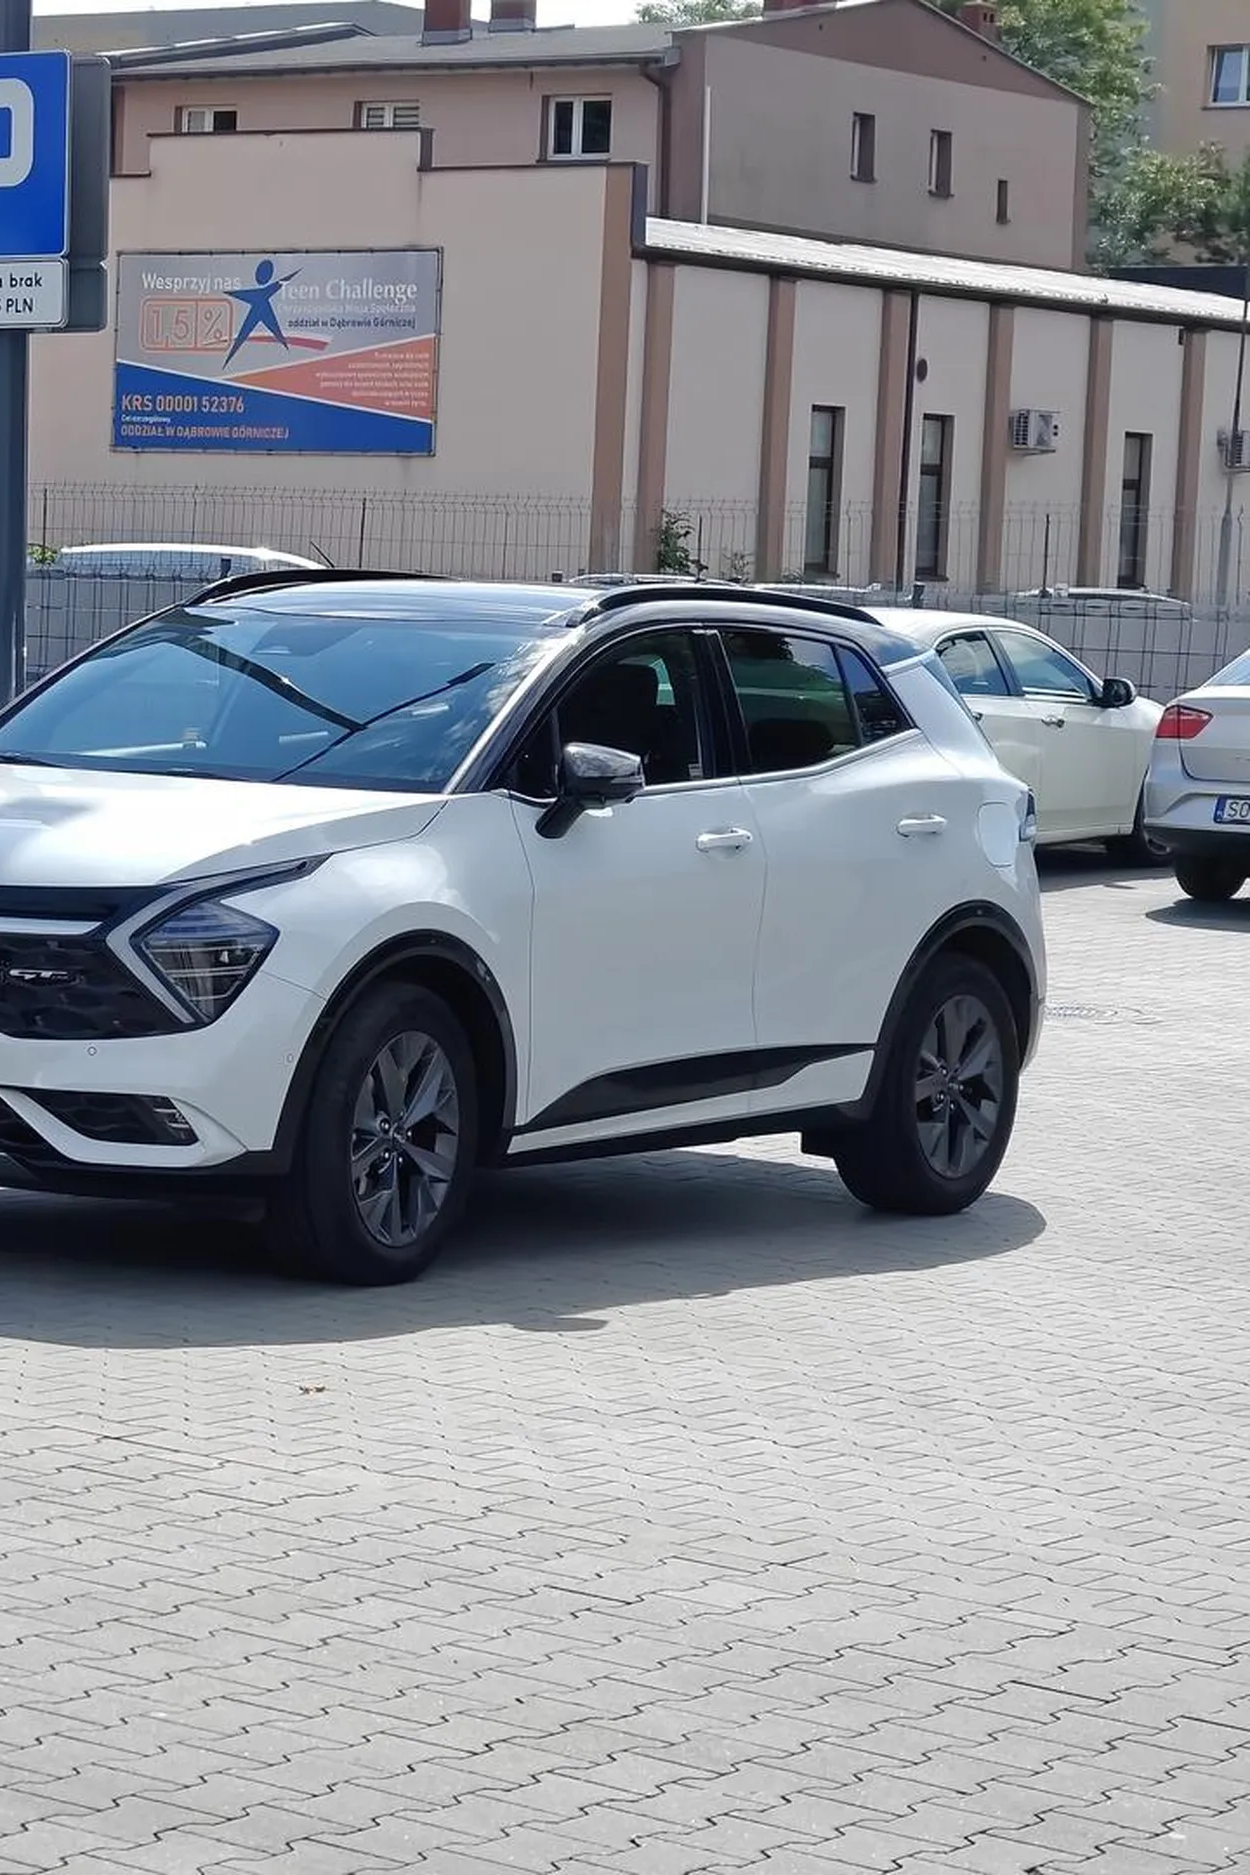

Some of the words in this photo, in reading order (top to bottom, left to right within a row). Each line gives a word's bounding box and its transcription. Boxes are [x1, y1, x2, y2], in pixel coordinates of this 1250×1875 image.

[9, 272, 43, 288] brak
[141, 271, 211, 294] Wesprzyj
[213, 276, 242, 290] nas
[325, 277, 418, 305] Challenge
[6, 298, 34, 313] PLN
[122, 395, 153, 411] KRS
